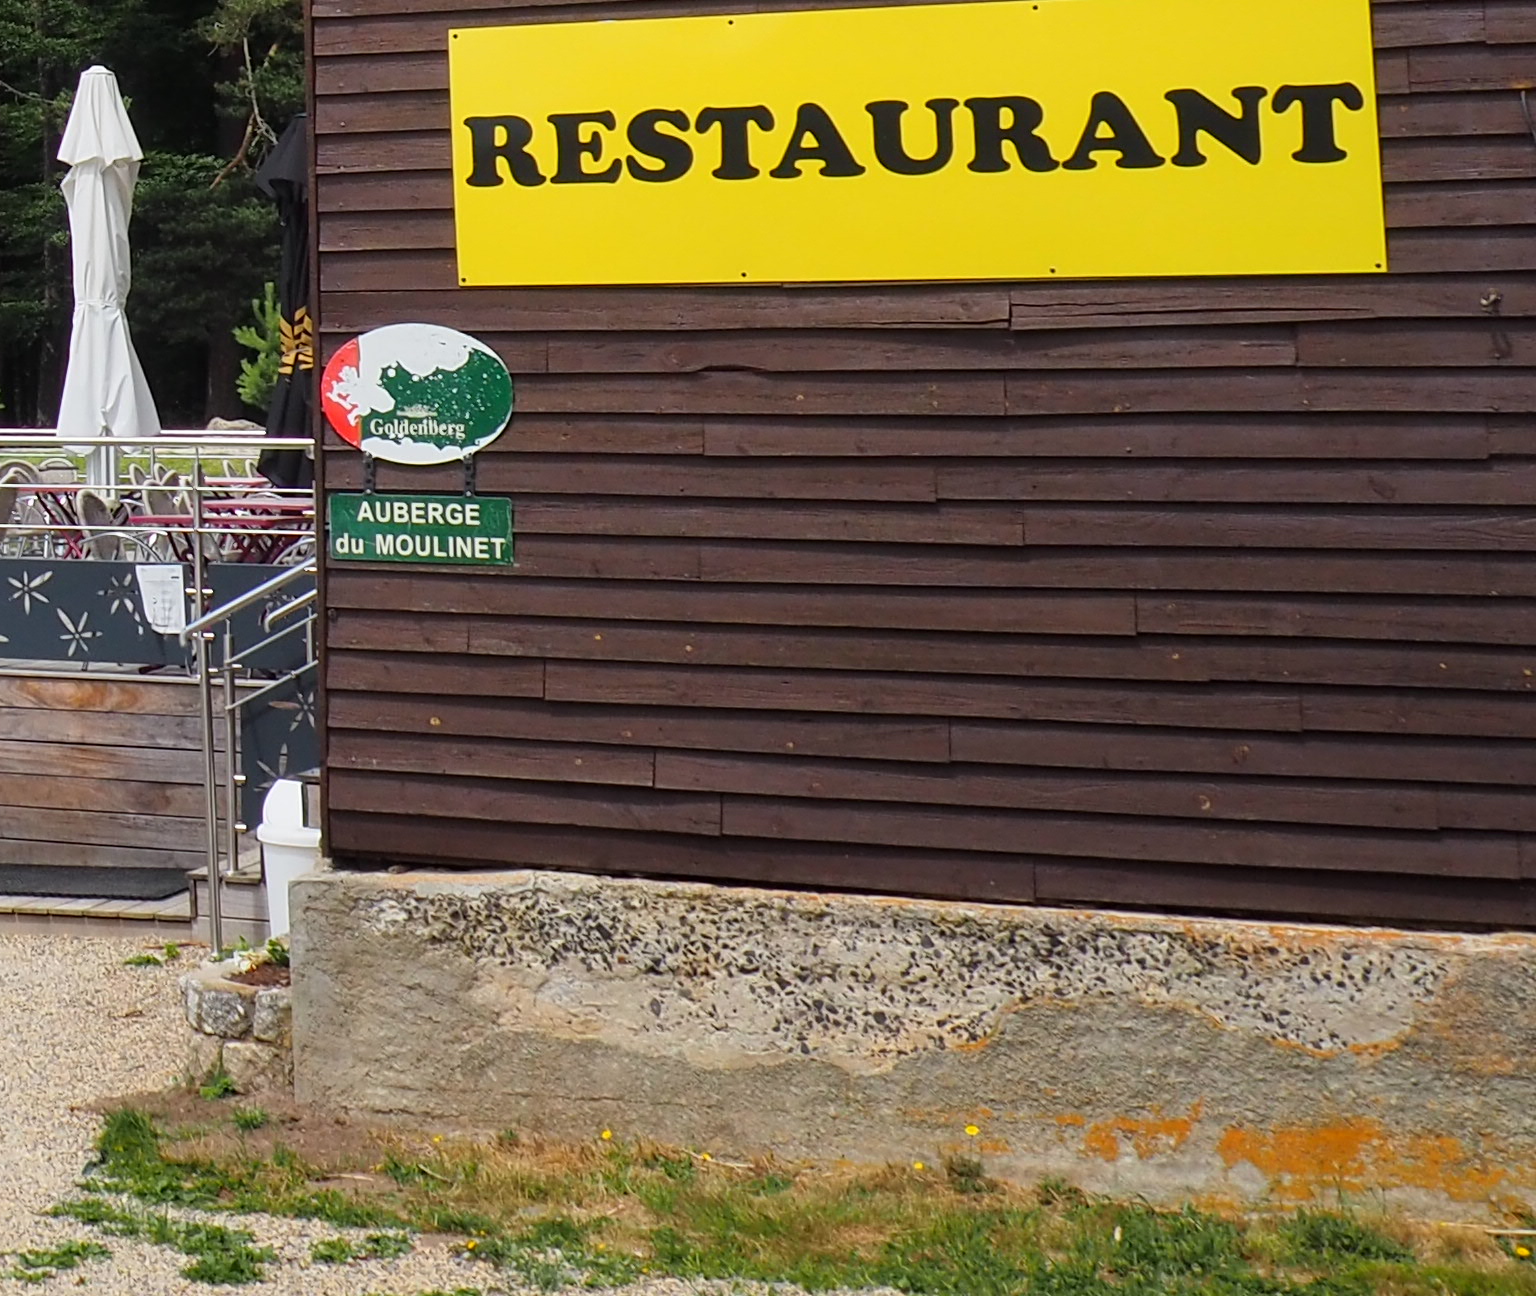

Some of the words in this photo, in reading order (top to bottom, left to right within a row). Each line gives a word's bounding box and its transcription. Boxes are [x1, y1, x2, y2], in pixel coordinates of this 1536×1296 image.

[464, 82, 1364, 188] RESTAURANT
[369, 417, 466, 439] Goldenberg
[357, 501, 480, 525] AUBERGE
[335, 533, 364, 554] du
[376, 534, 506, 559] MOULINET
